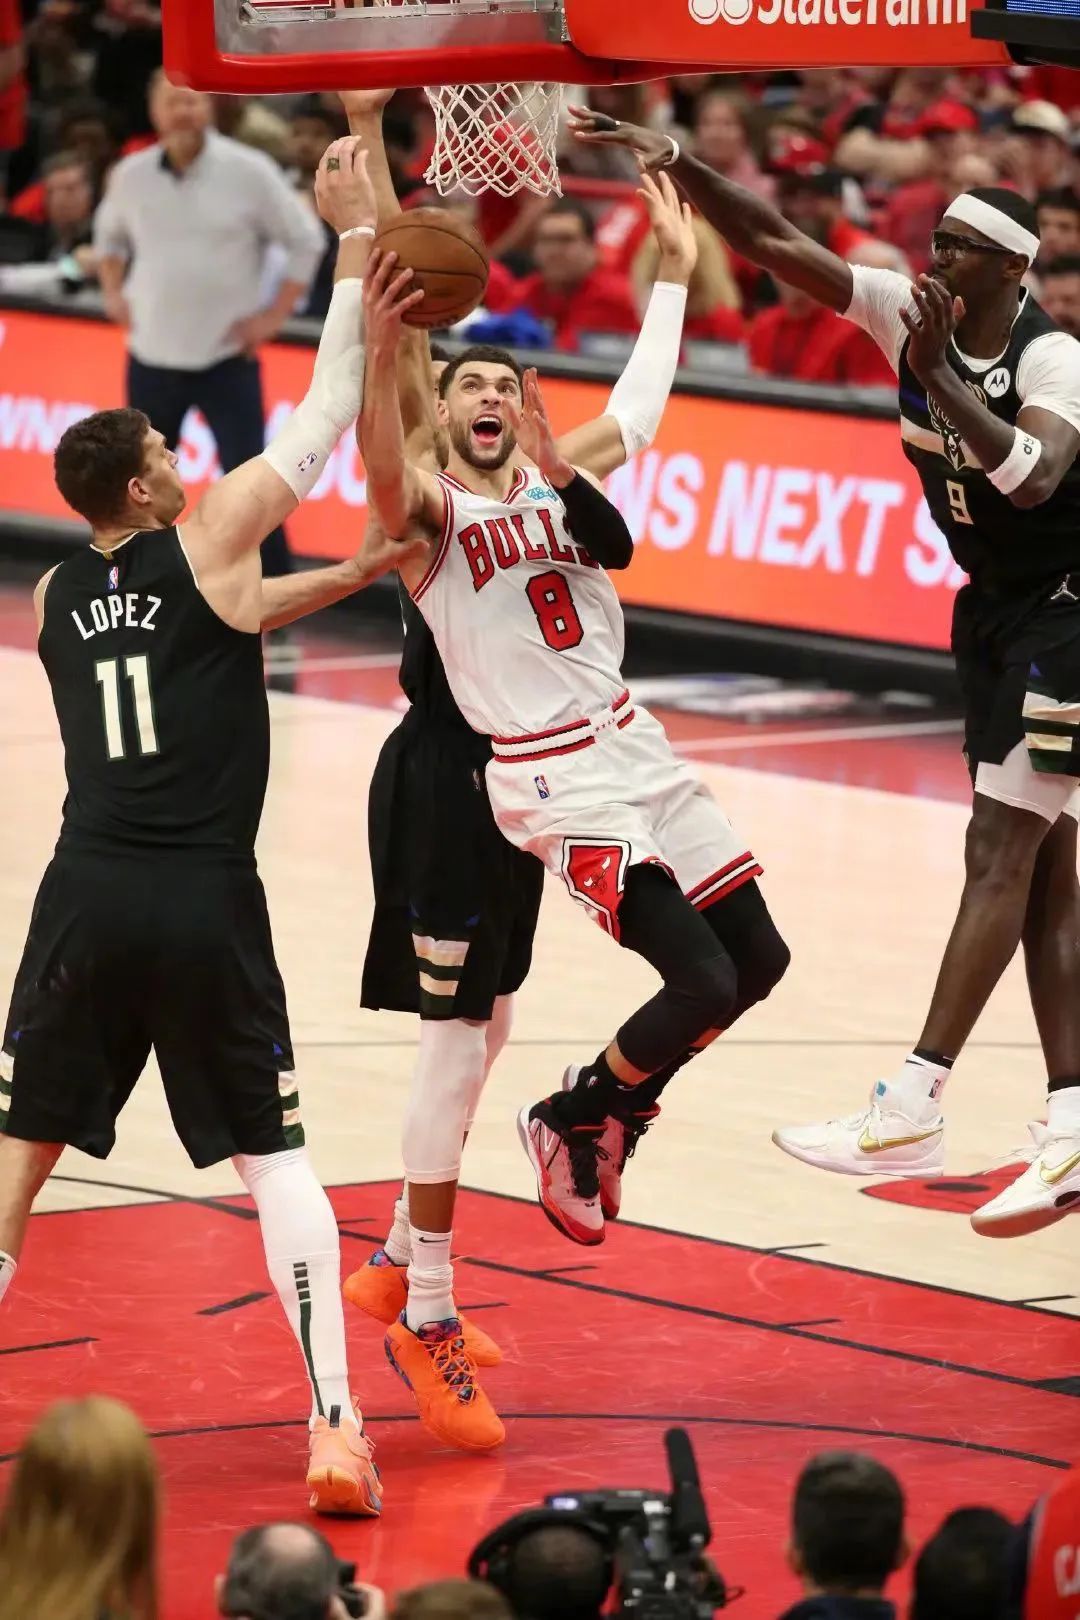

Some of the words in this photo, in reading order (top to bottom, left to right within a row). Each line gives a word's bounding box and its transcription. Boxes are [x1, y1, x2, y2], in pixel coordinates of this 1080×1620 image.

[708, 460, 905, 577] NEXT
[946, 479, 974, 525] 9
[71, 593, 162, 641] LOPEZ
[525, 570, 584, 652] 8
[96, 655, 158, 760] 11
